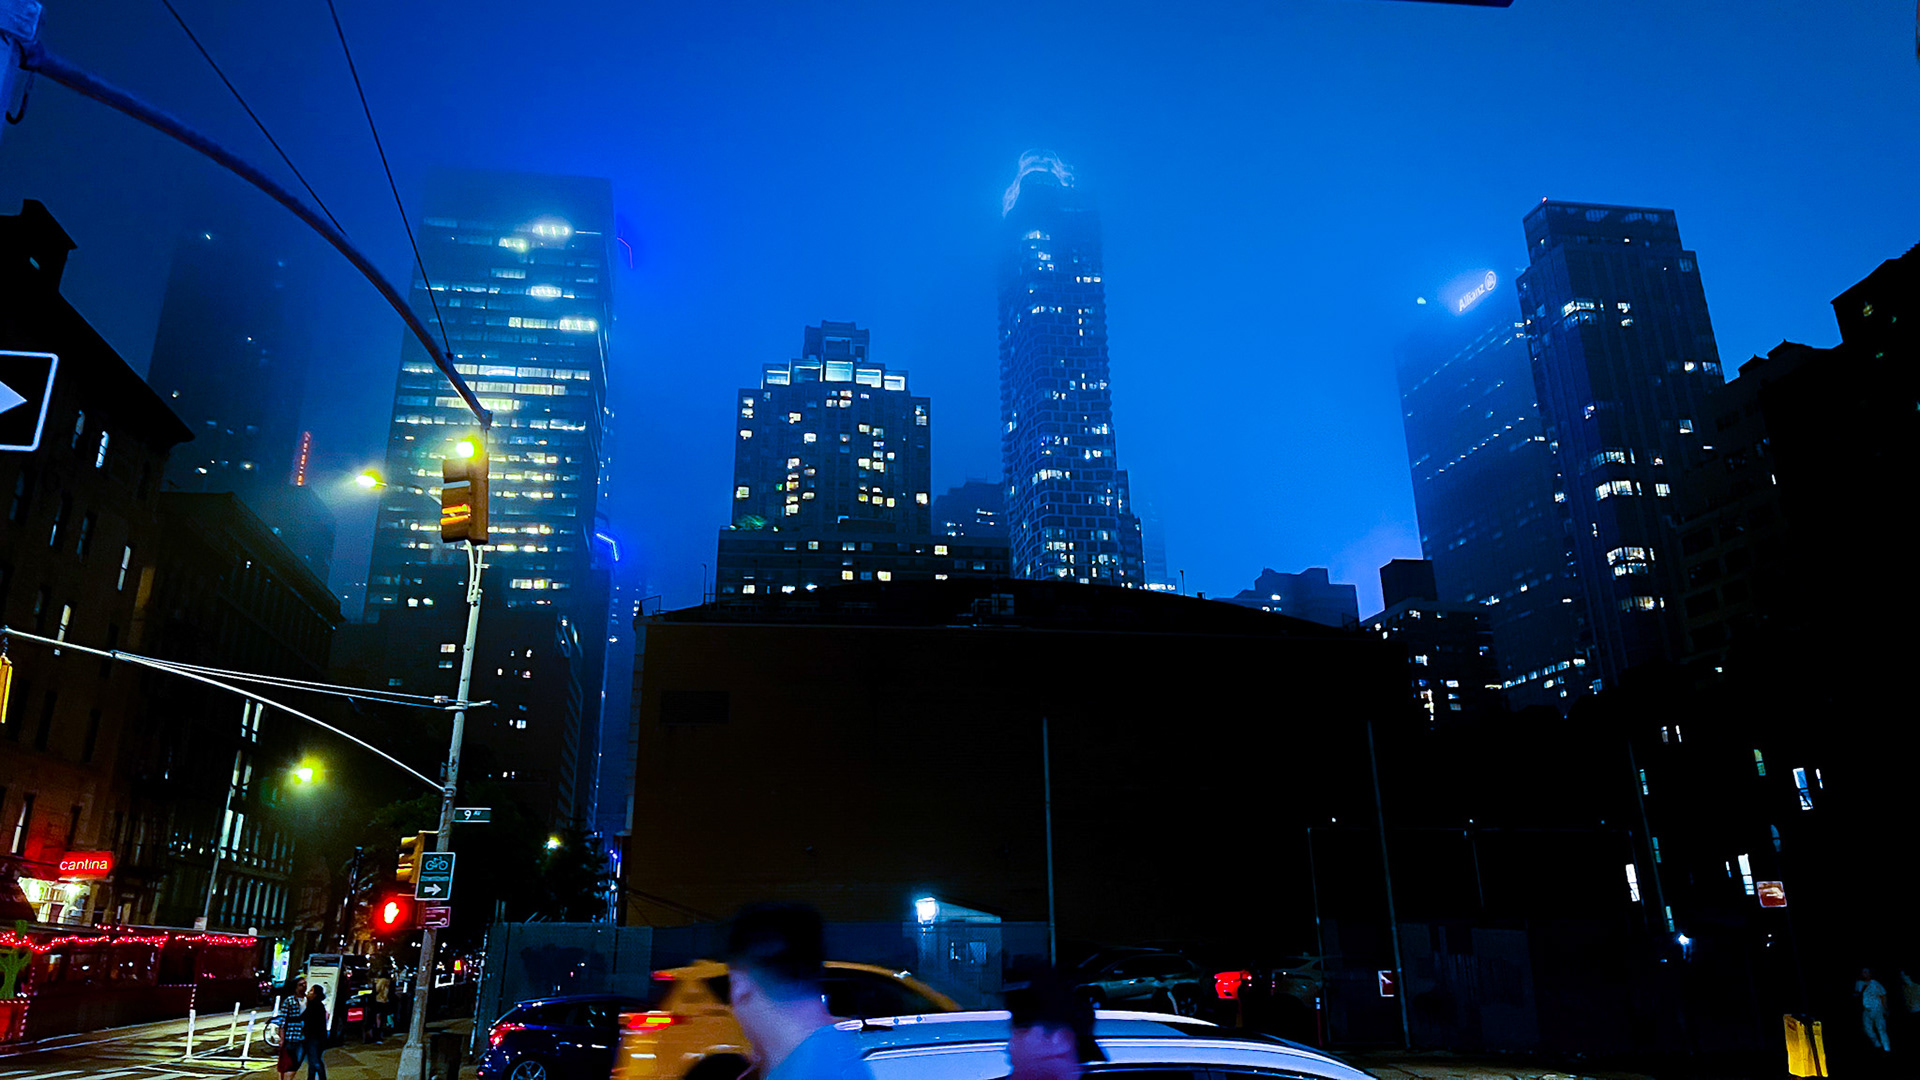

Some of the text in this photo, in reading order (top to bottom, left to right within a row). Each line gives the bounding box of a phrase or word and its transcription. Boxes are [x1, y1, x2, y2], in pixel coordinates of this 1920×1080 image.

[1459, 283, 1485, 312] Allianz
[464, 810, 472, 820] 9
[59, 858, 108, 871] cantina
